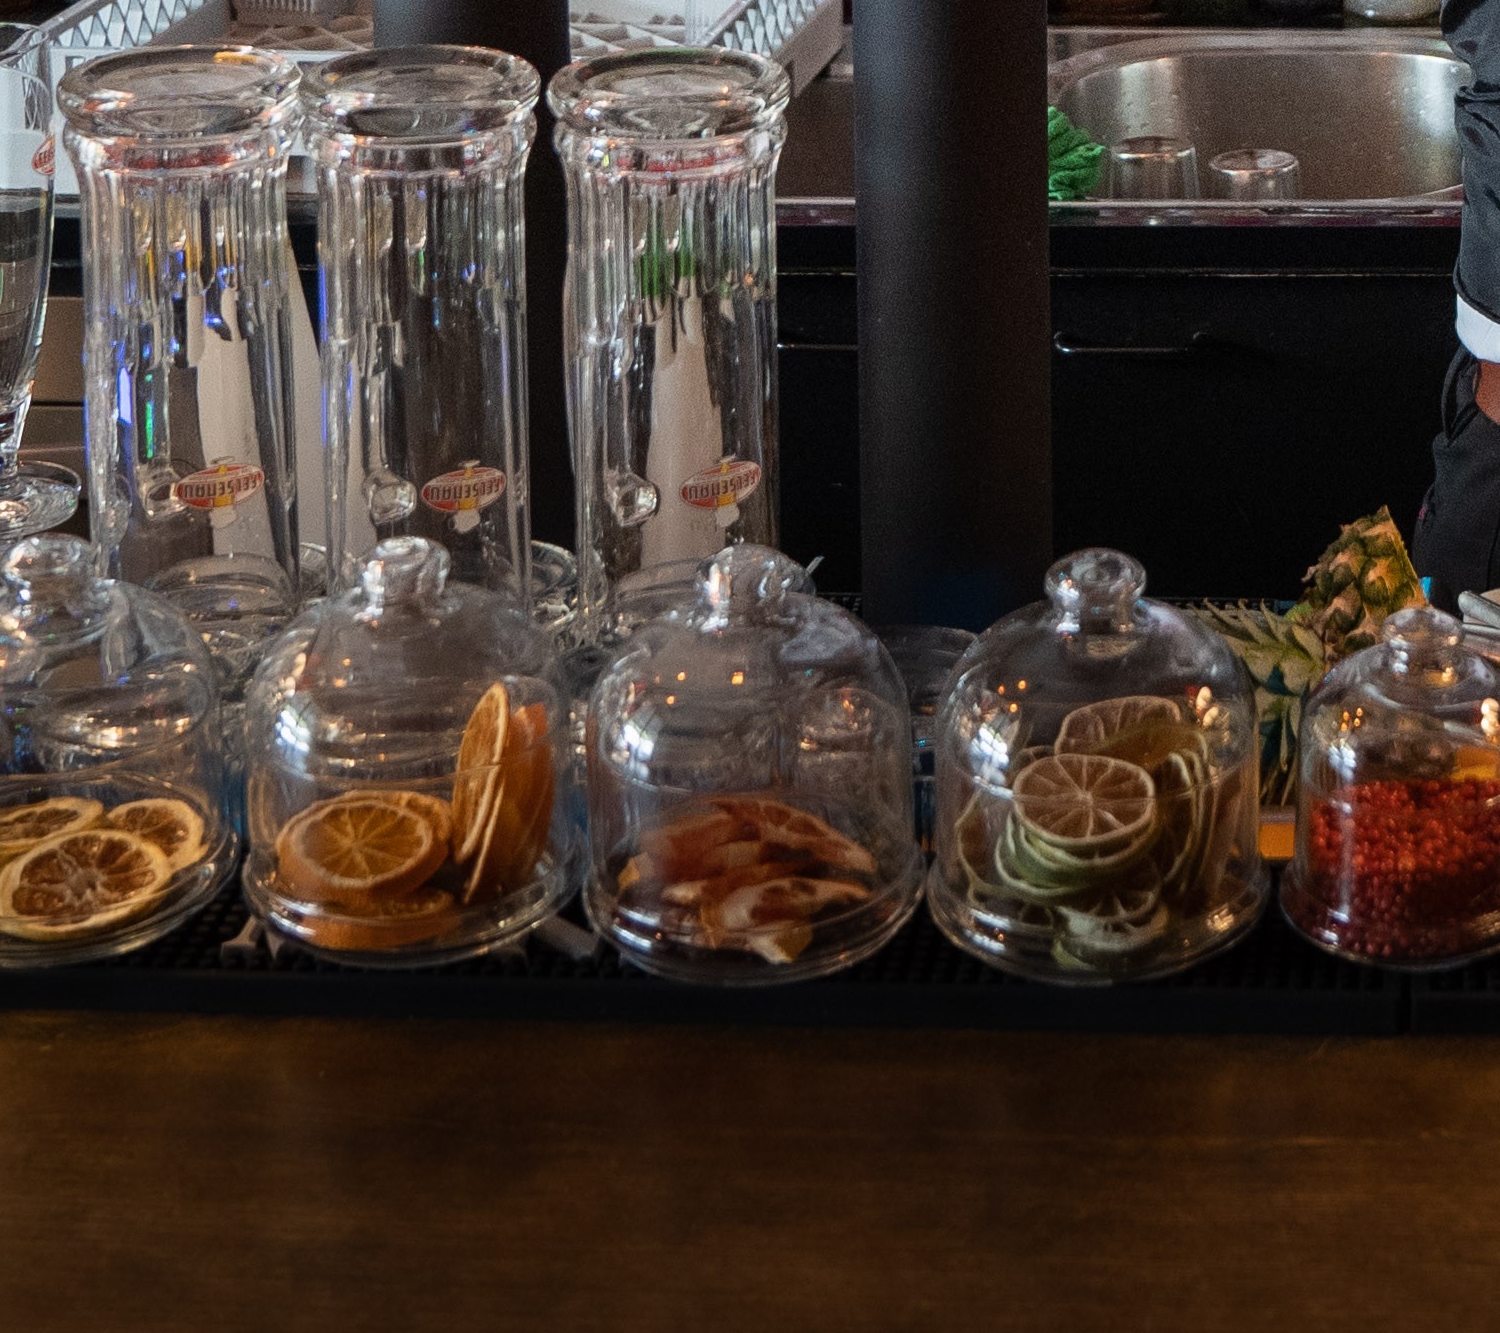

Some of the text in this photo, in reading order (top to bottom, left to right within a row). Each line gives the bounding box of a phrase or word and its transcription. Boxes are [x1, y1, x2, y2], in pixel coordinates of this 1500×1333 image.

[183, 474, 259, 497] FELSENAU
[429, 478, 501, 502] FELSENAU
[686, 473, 757, 501] FELSENAU
